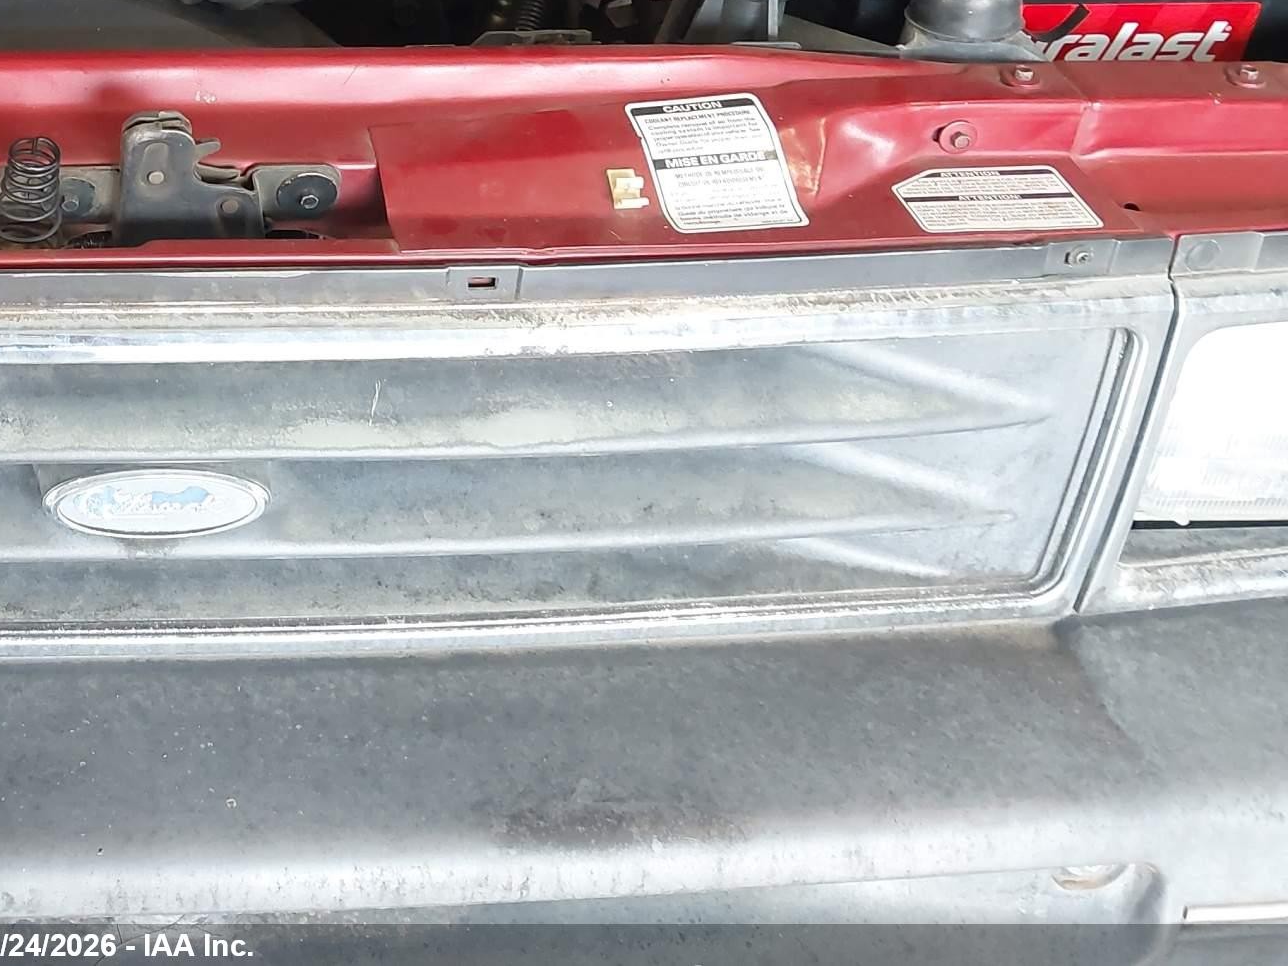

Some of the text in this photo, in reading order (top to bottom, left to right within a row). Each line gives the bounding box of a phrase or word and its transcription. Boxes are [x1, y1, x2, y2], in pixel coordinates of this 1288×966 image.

[663, 101, 722, 113] CAUTION
[664, 151, 767, 169] MISE EN GARDE
